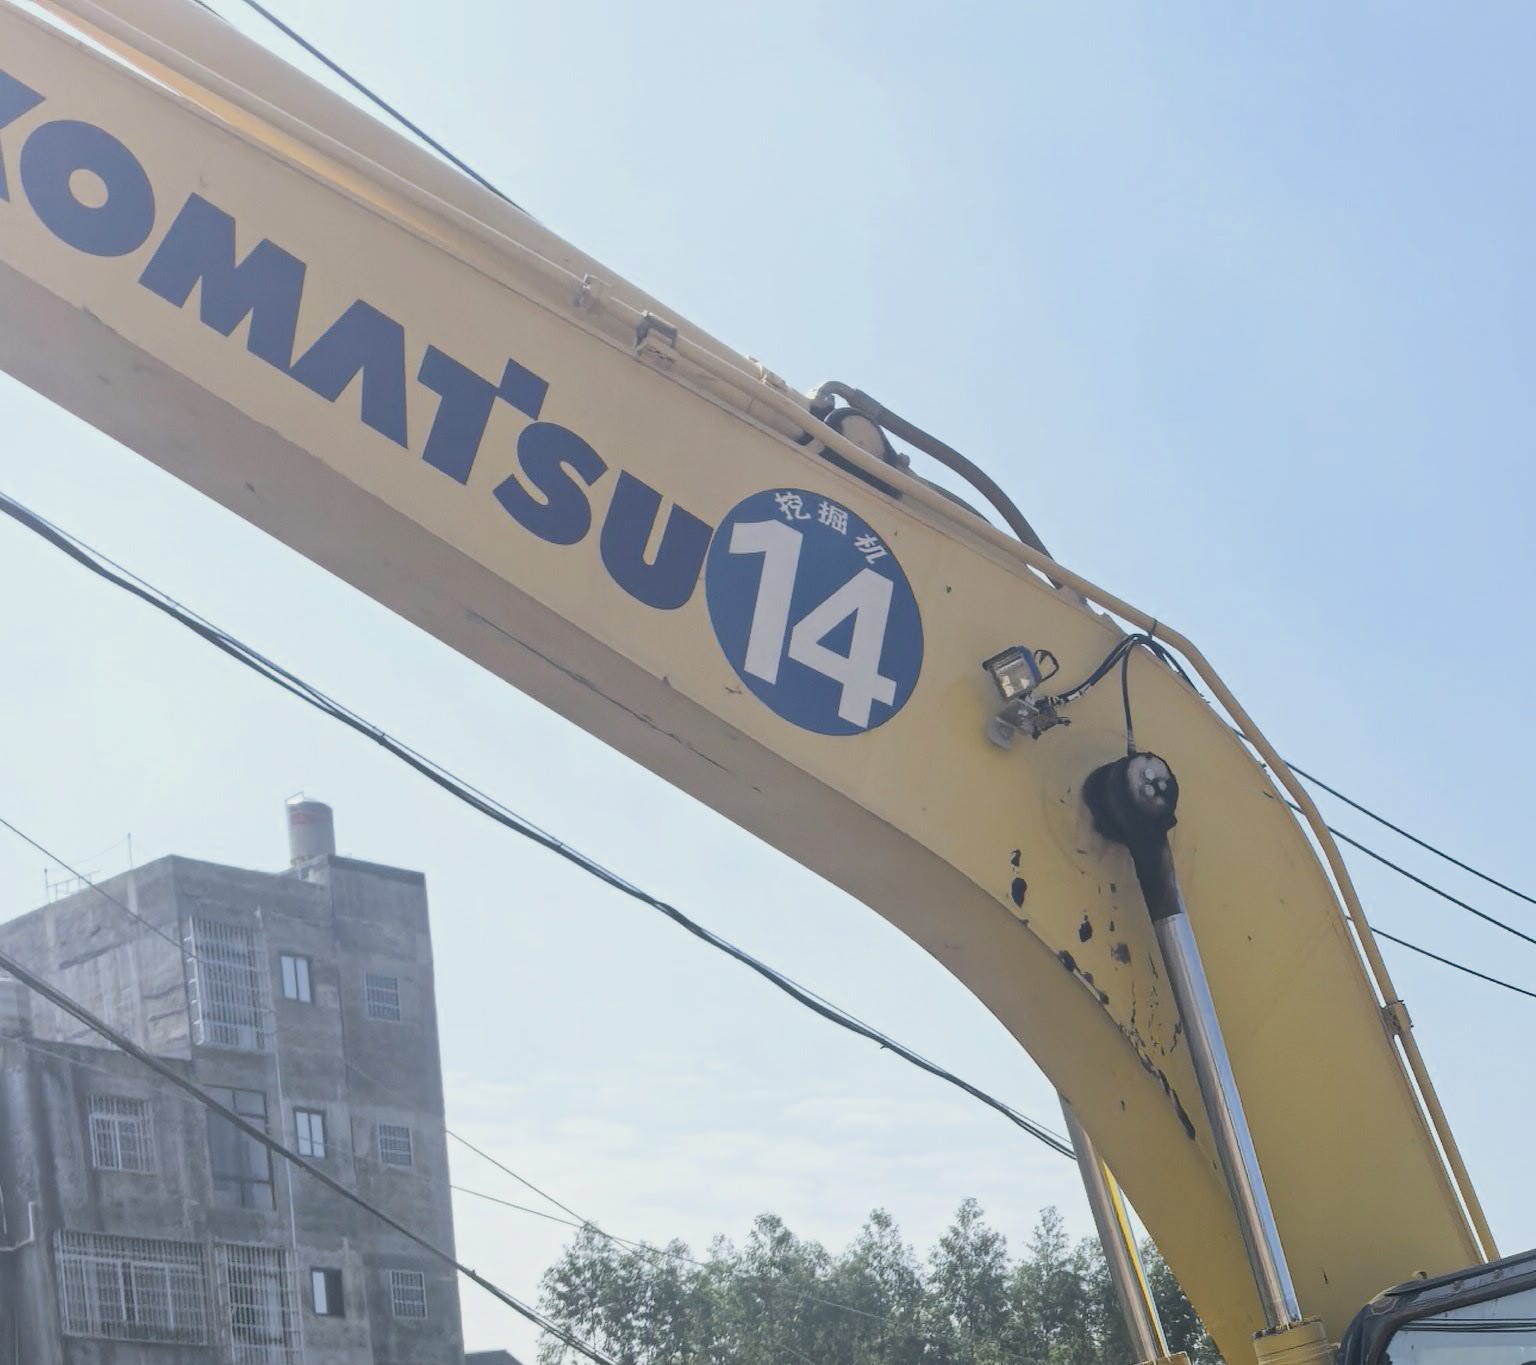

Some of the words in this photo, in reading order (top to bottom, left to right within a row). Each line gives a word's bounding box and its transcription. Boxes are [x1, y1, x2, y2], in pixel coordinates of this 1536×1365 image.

[774, 491, 889, 565] 挖掘机
[728, 519, 898, 729] 14
